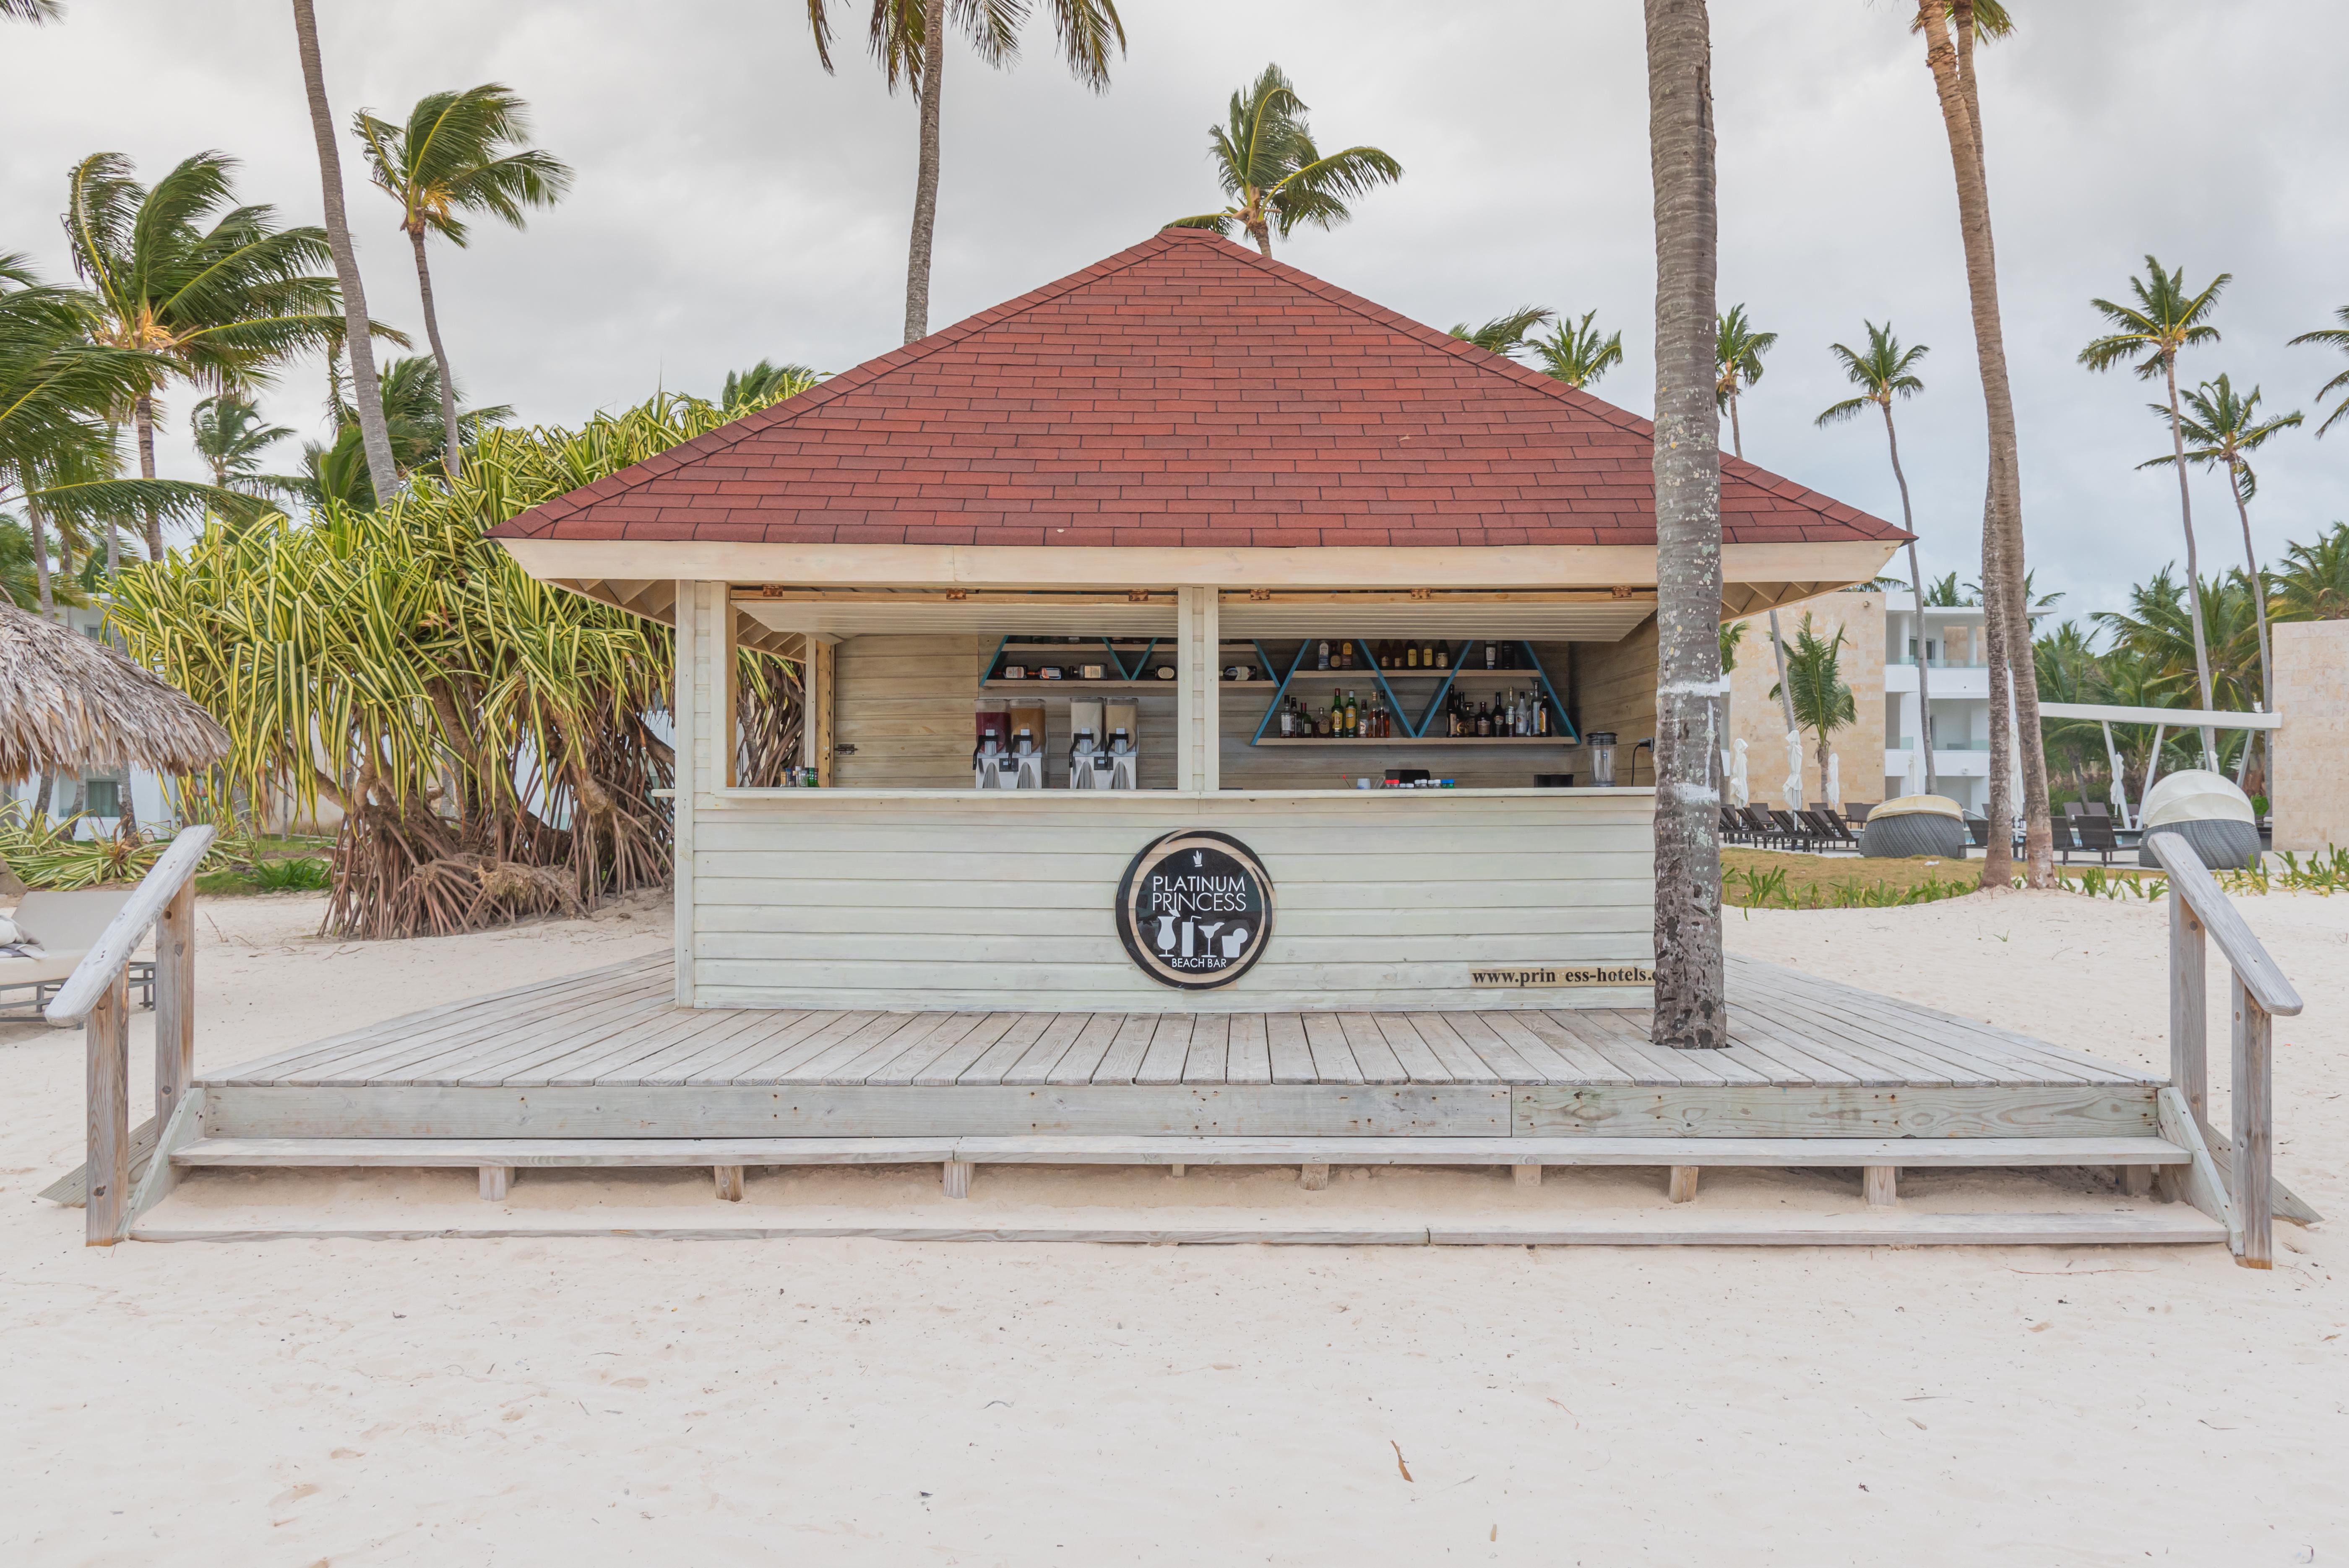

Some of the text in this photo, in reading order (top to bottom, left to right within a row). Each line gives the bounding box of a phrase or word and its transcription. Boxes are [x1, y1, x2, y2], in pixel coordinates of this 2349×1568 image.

[1153, 876, 1245, 892] PLATINUM
[1153, 892, 1246, 912] PRINCESS
[1172, 958, 1227, 968] BEACH BAR
[1472, 967, 1656, 987] www.priness-hotels.
